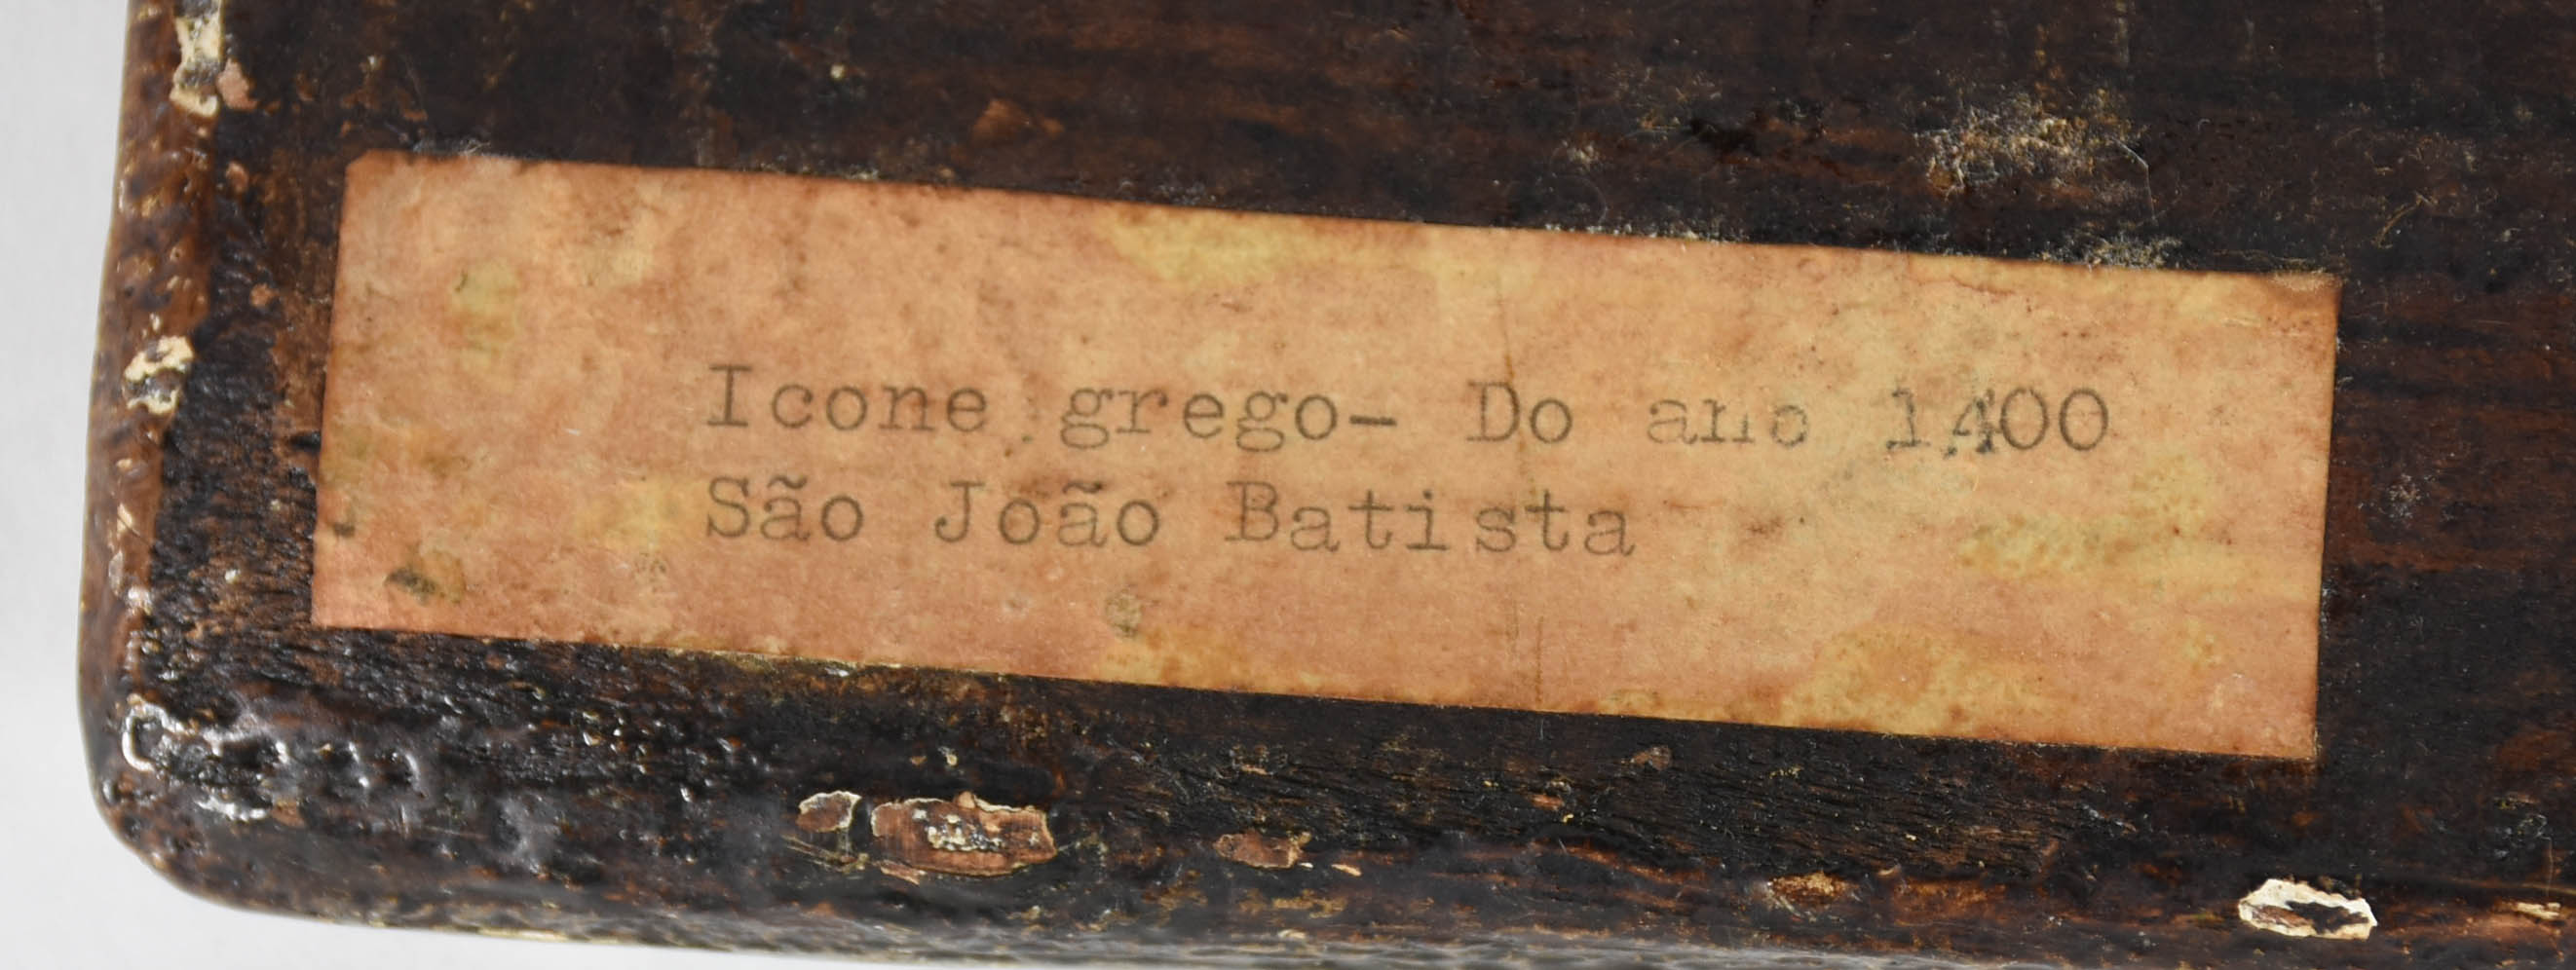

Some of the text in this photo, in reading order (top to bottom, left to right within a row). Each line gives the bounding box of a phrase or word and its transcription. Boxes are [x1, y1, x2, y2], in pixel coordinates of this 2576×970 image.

[706, 364, 988, 431] Icone
[1465, 381, 1573, 445] Do
[1647, 398, 1809, 448] ano
[705, 474, 1636, 558] São João Batista
